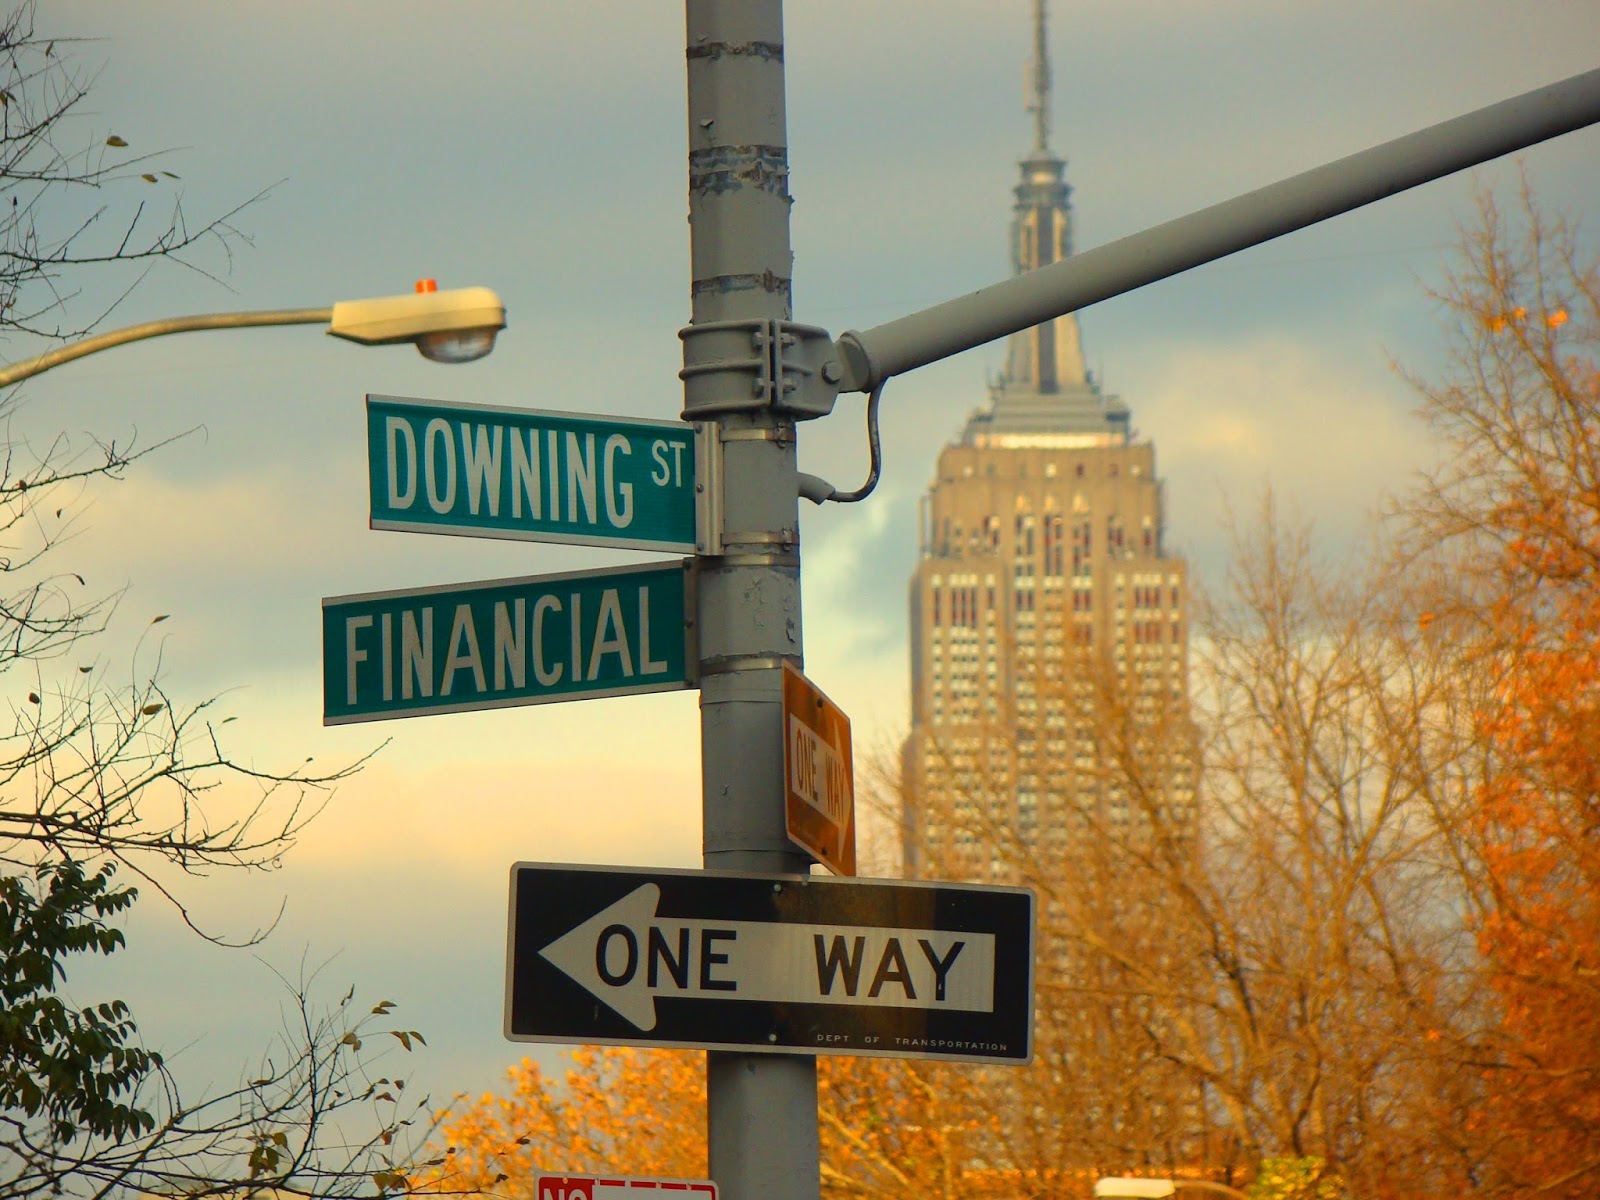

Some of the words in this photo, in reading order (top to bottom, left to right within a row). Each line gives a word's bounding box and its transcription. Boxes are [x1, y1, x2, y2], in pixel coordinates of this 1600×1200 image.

[385, 416, 634, 529] DOWNING
[651, 439, 687, 488] ST
[345, 585, 668, 706] FINANCIAL
[796, 727, 818, 802] ONE
[825, 751, 845, 824] WAY
[595, 923, 738, 992] ONE
[813, 933, 966, 1001] WAY
[816, 1033, 849, 1042] DEPT
[864, 1036, 880, 1044] OF
[894, 1037, 1008, 1051] TRANSPORTATION
